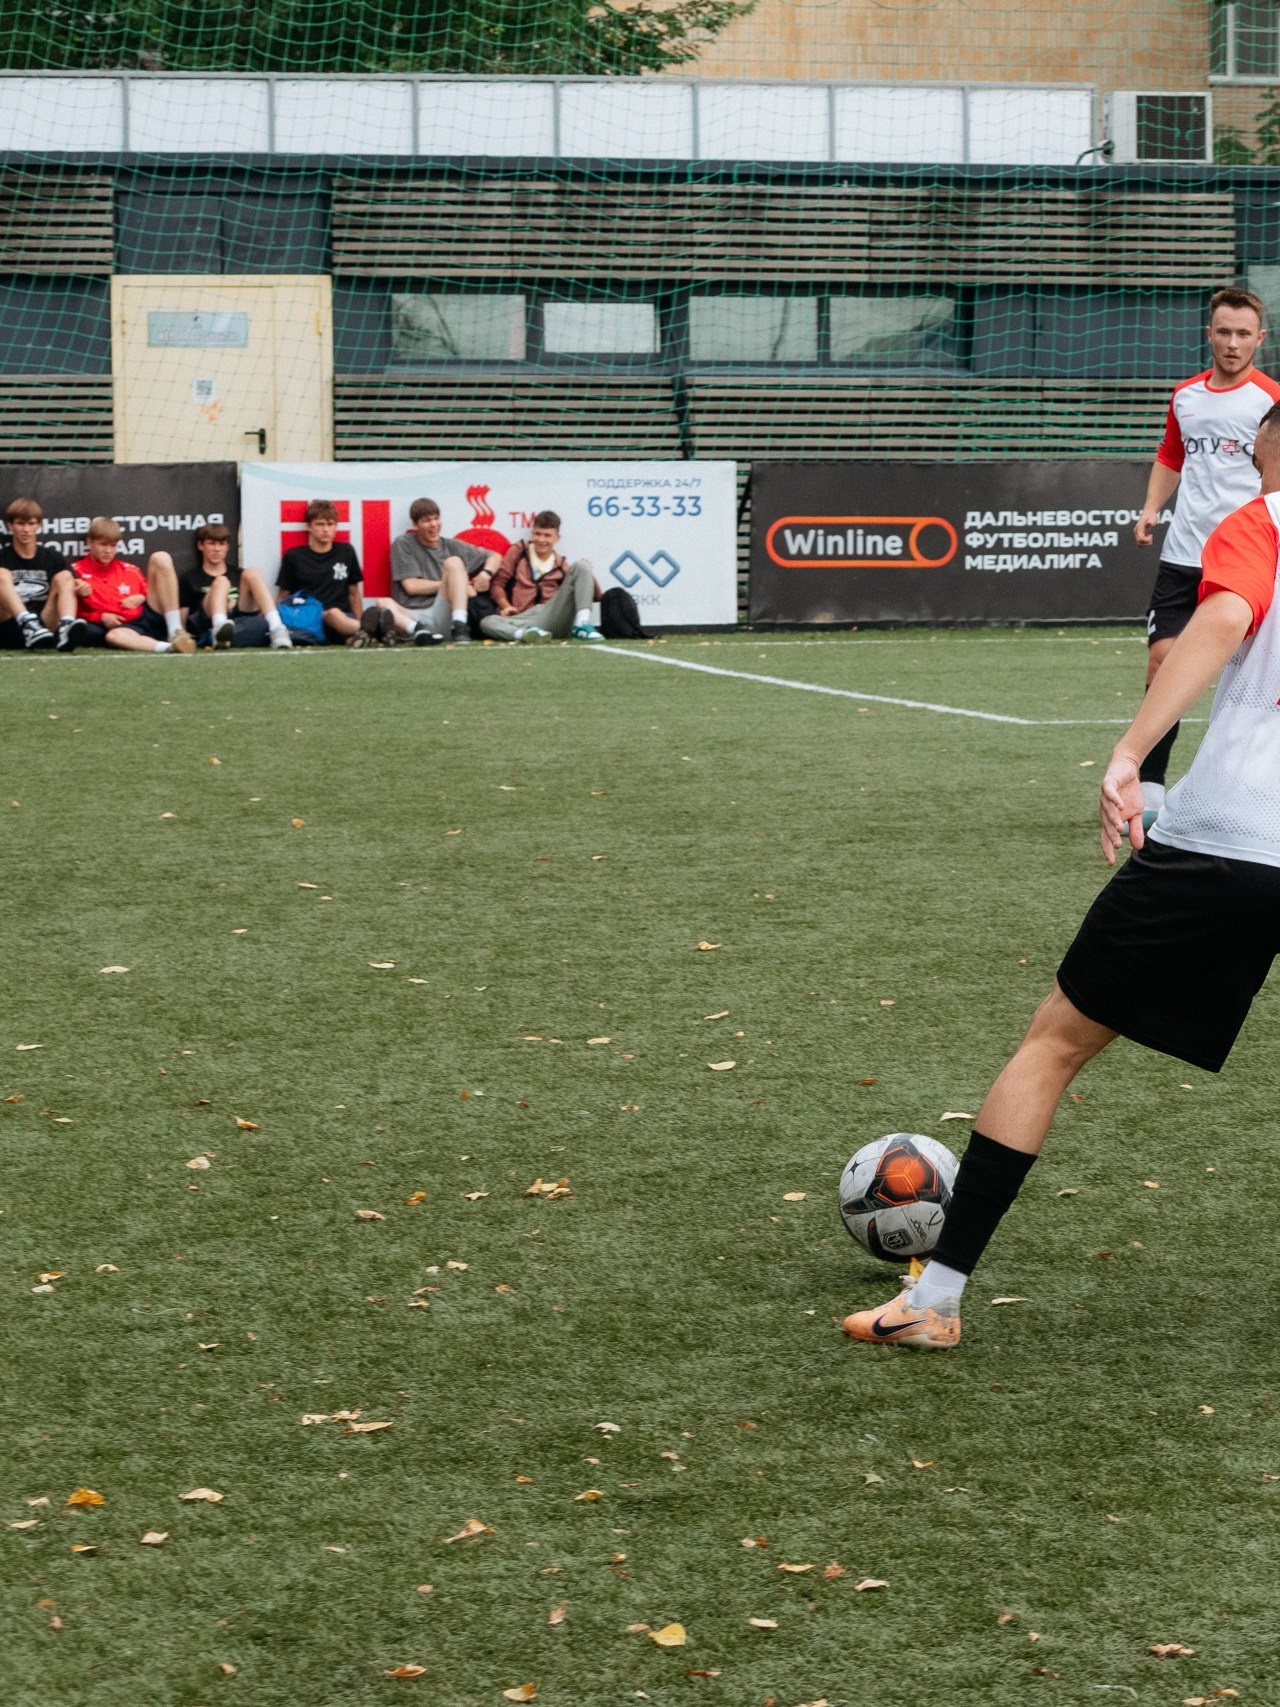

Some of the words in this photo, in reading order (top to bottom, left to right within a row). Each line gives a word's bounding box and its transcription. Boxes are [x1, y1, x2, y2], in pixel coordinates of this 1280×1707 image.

[587, 478, 671, 489] ПОДДЕРЖКА
[674, 478, 702, 489] 24/7
[587, 496, 702, 517] 66-33-33
[964, 509, 1173, 529] ДАЛЬНЕВОСТОЧА
[783, 529, 903, 556] Winline
[964, 531, 1119, 549] ФУТБОЛЬНАЯ
[964, 553, 1103, 572] МЕДИАЛИГА
